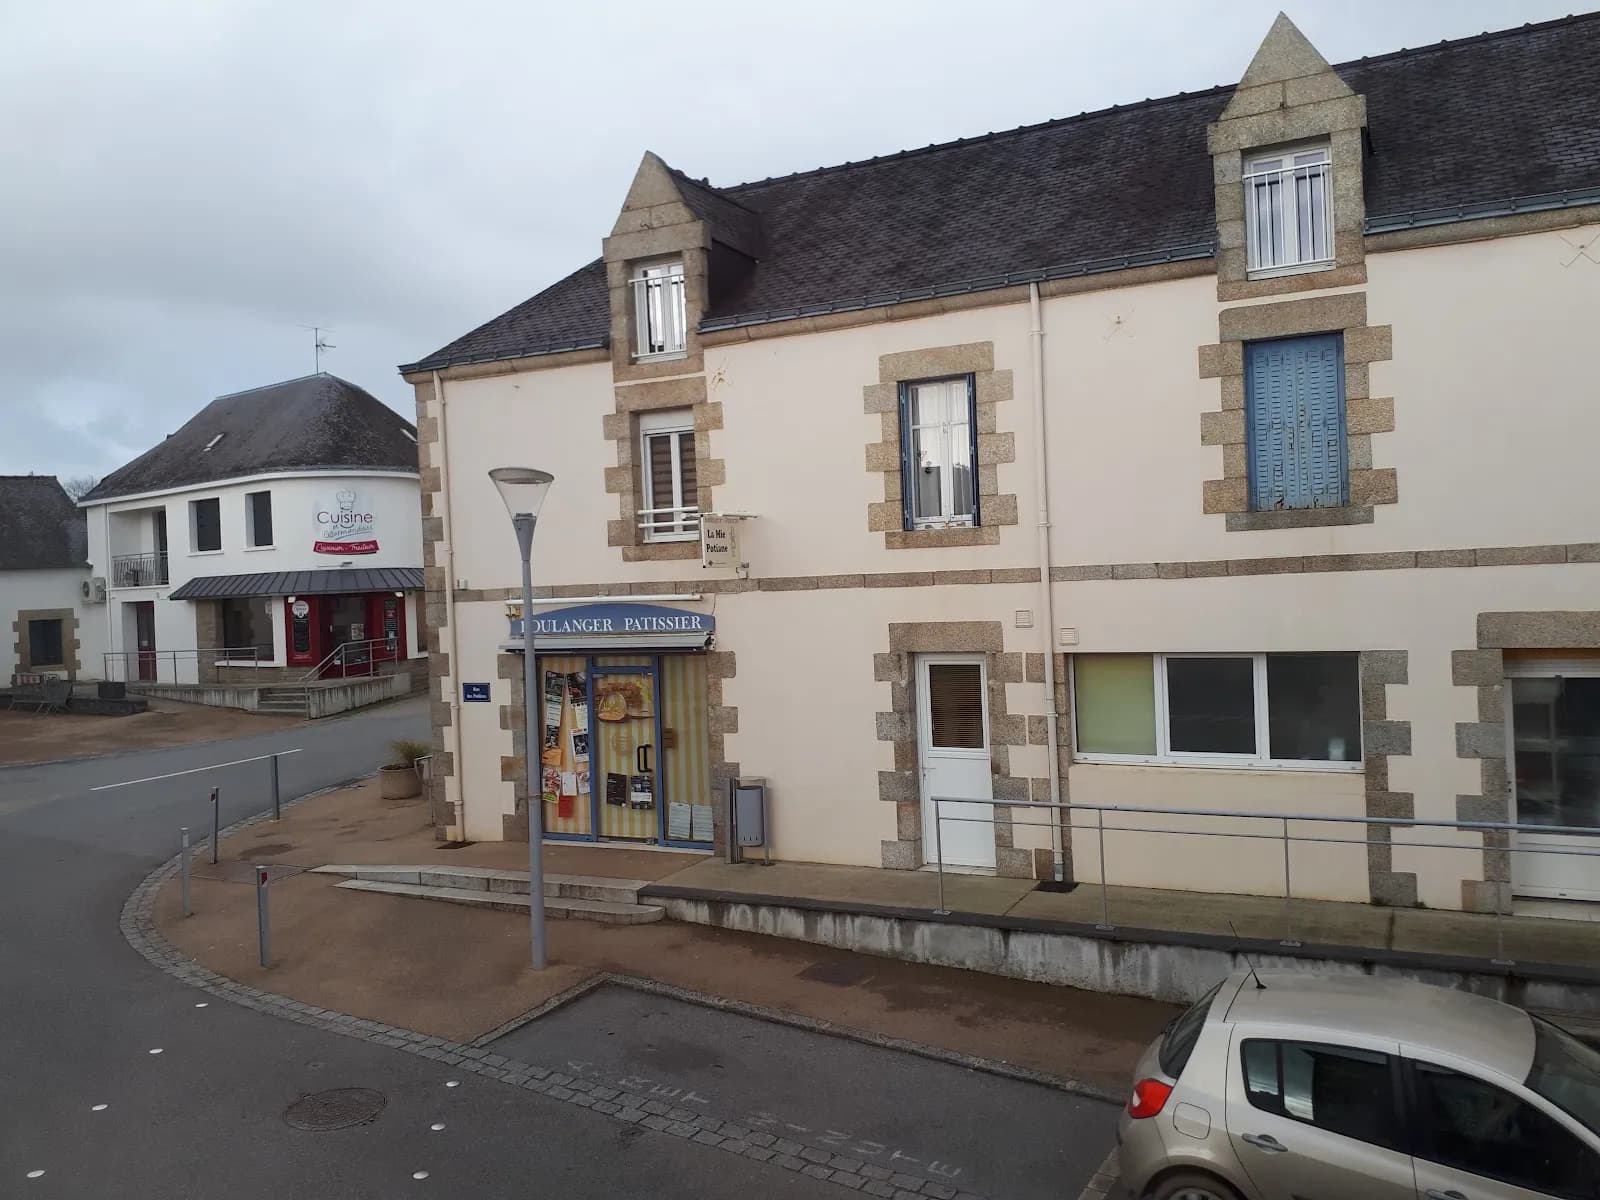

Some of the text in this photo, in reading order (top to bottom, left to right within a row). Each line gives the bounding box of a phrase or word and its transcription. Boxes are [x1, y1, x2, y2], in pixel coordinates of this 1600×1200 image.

[317, 510, 373, 524] Cuisine
[707, 529, 726, 539] La Mie
[624, 615, 701, 631] PATISSIER
